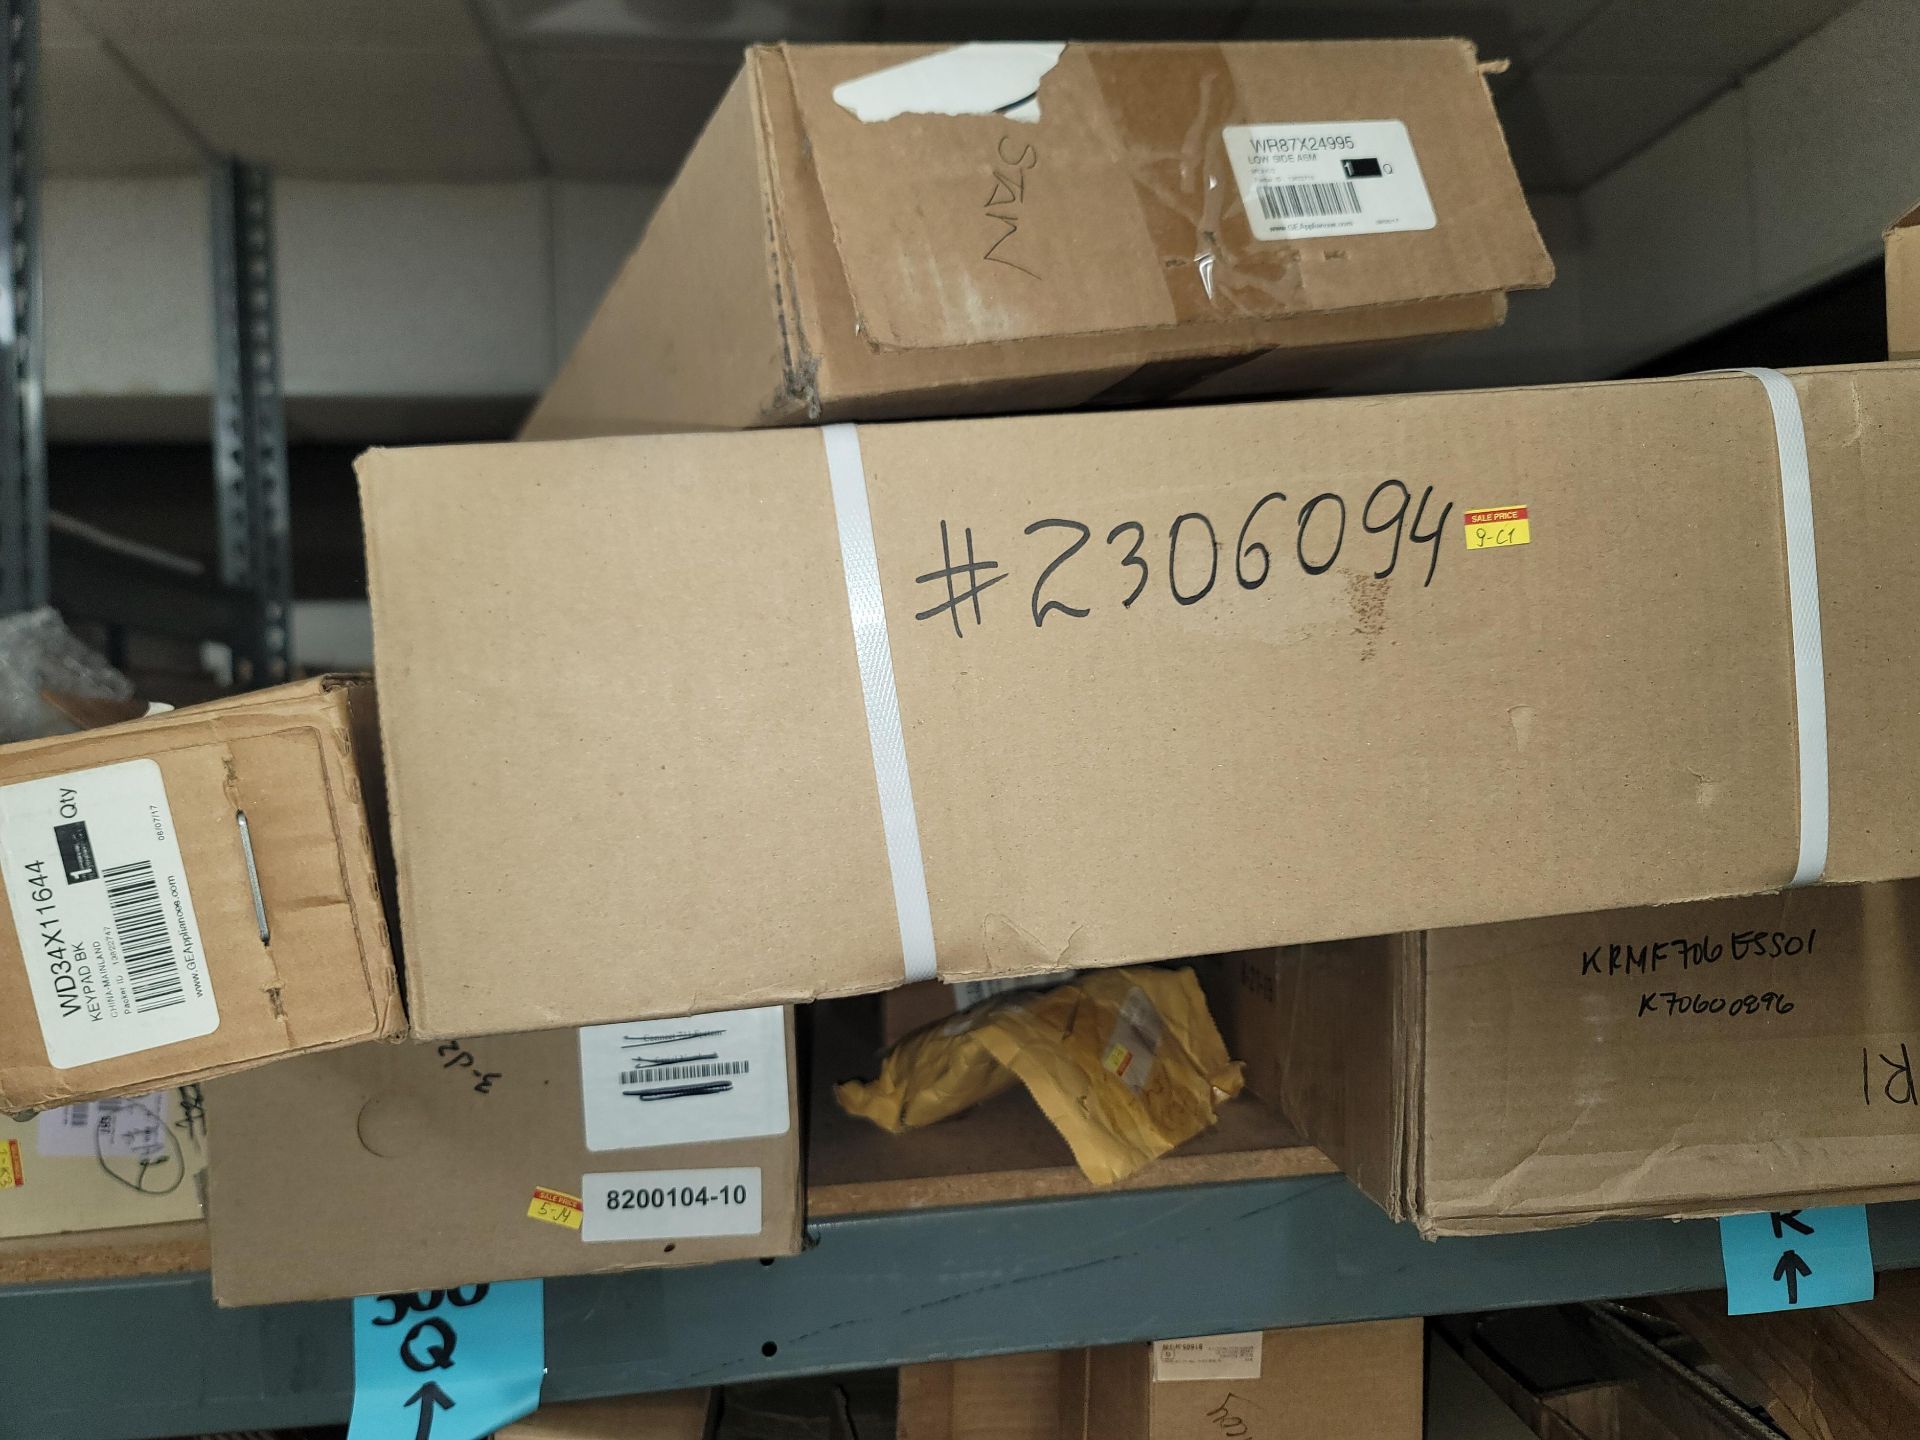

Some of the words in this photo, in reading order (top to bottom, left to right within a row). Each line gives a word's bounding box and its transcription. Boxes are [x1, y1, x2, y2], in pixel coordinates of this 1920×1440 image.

[1249, 136, 1355, 153] WR87X24995
[1273, 154, 1295, 164] SIDE
[1471, 514, 1493, 523] SALE
[1493, 511, 1519, 521] PRICE
[915, 479, 1453, 639] #2306094
[59, 787, 78, 819] Qty
[24, 859, 81, 1018] WD34X11644
[73, 941, 88, 962] BK
[167, 874, 204, 998] www.GEAppliances.com
[78, 967, 104, 1022] KEYPAD
[92, 940, 119, 1018] CHINA-MAINLAND
[539, 1192, 558, 1202] SALE
[558, 1196, 578, 1208] PRICE
[606, 1184, 748, 1211] 8200104-10
[400, 1316, 457, 1373] Q
